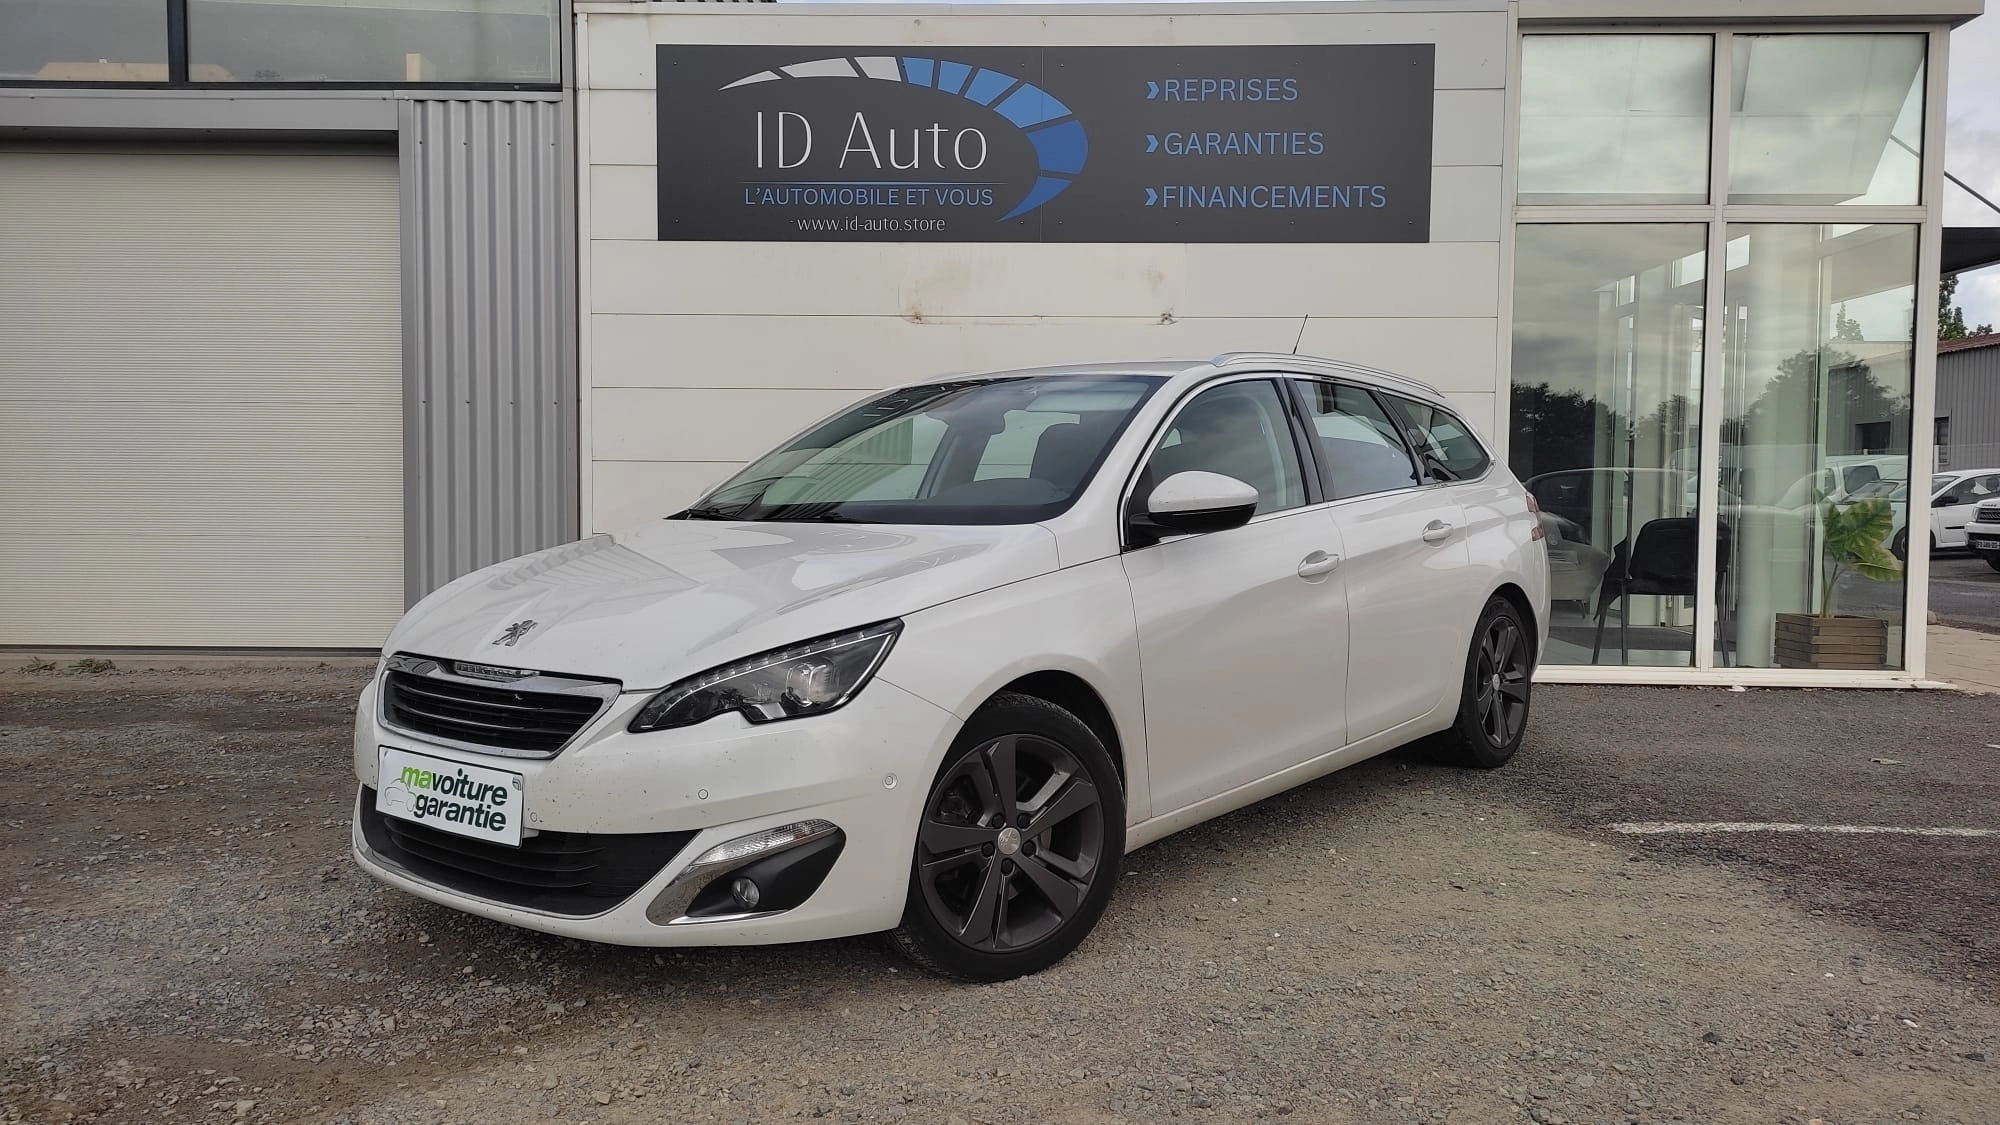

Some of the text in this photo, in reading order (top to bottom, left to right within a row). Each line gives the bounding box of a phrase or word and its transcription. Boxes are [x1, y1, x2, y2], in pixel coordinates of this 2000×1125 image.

[1164, 77, 1298, 102] REPRISES
[756, 111, 988, 170] ID Auto
[1163, 131, 1325, 155] GARANTIES
[905, 188, 930, 205] ET
[934, 187, 994, 206] VOUS
[1162, 184, 1387, 209] FINANCEMENTS
[796, 215, 946, 232] www.id-auto.store
[413, 794, 507, 831] garantie
